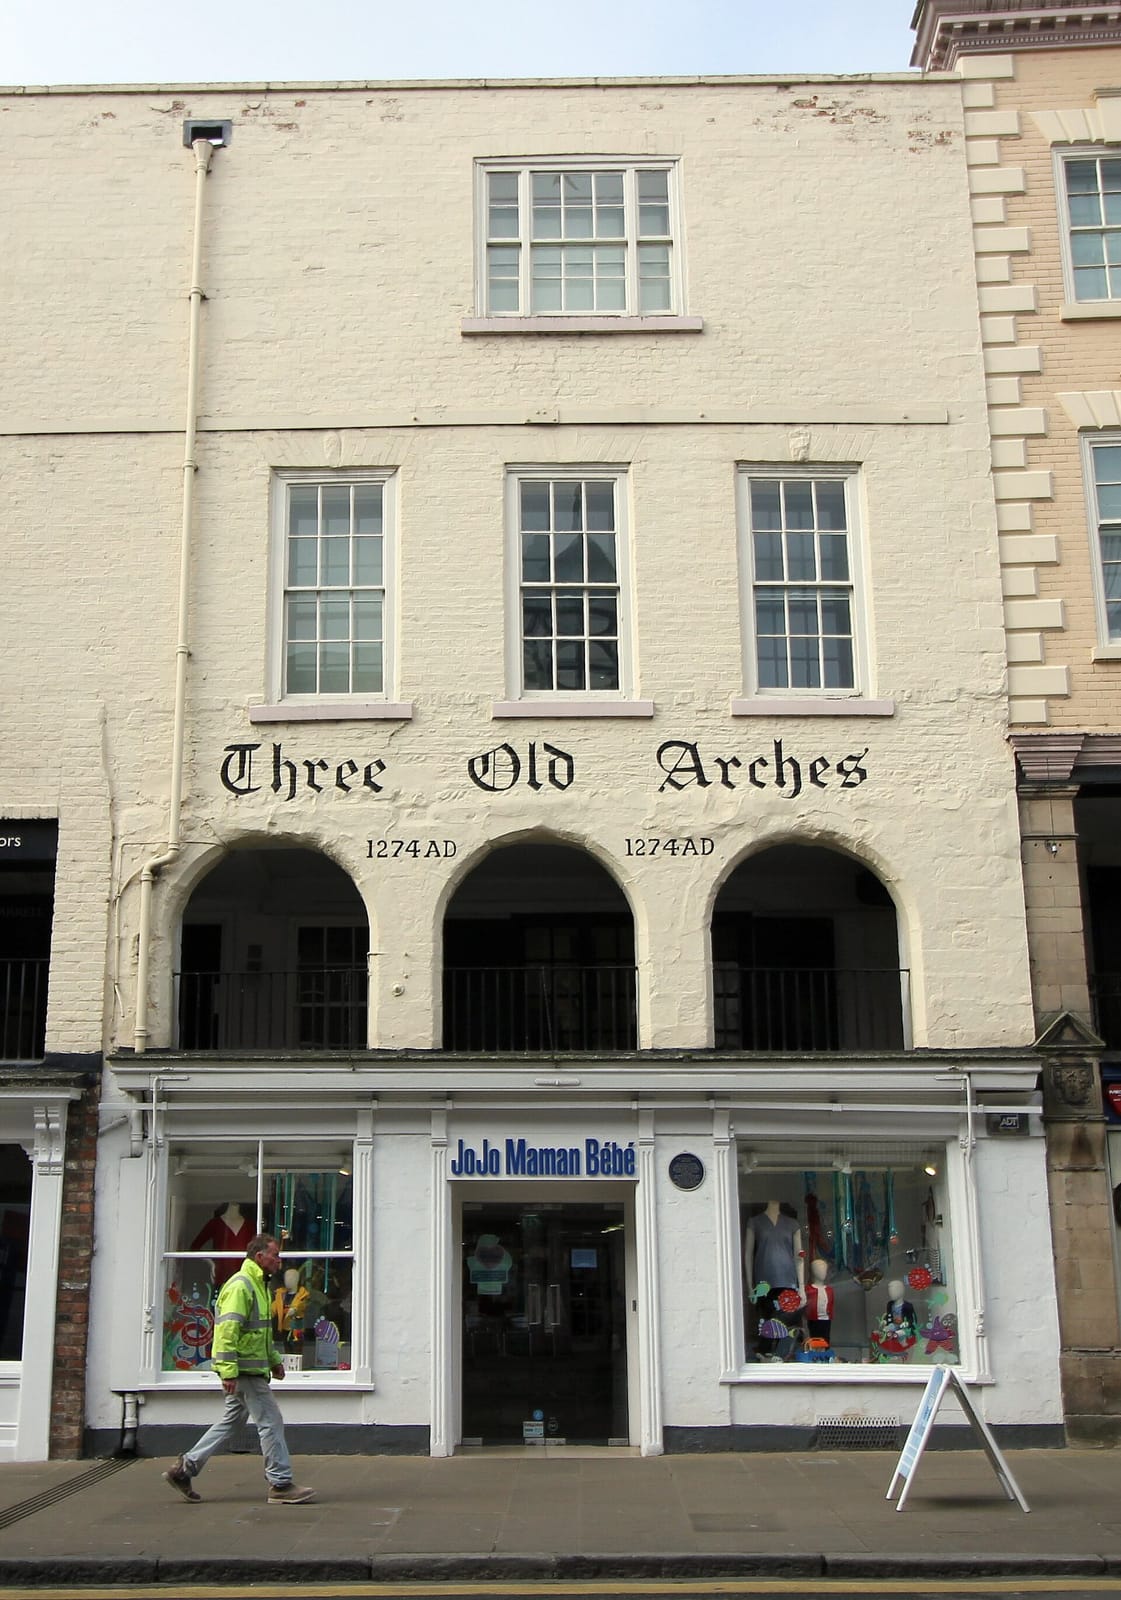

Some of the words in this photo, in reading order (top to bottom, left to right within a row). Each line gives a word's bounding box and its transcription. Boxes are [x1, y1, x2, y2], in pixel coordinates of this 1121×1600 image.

[221, 743, 387, 801] Three
[468, 742, 575, 792] Old
[656, 738, 869, 799] Arches
[451, 1139, 500, 1175] JoJo
[506, 1138, 581, 1175] Maman
[586, 1138, 636, 1176] Bébé
